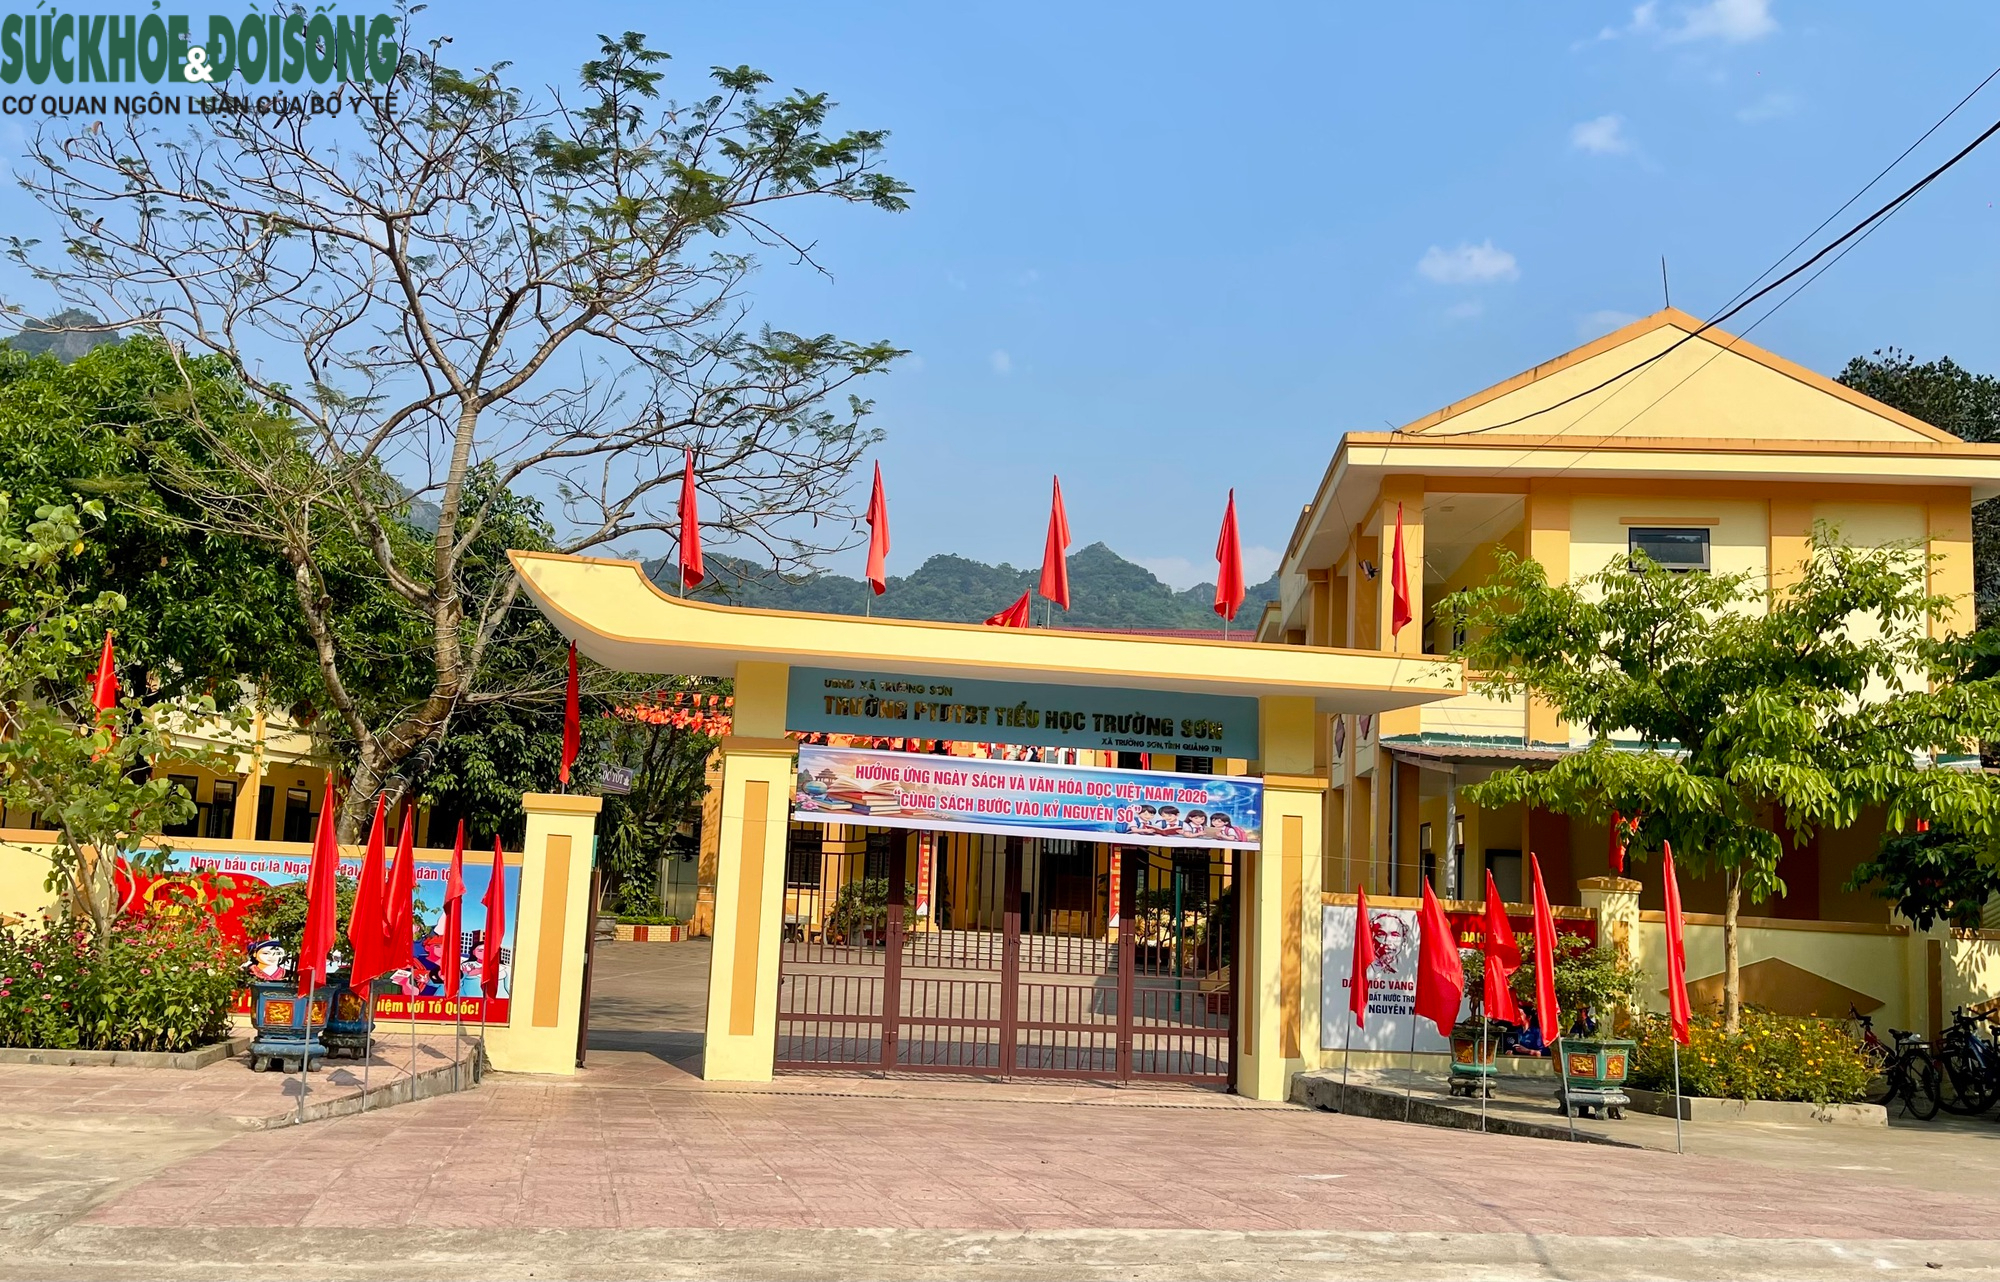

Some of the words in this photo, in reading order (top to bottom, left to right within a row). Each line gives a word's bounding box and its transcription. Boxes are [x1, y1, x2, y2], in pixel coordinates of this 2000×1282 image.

[860, 679, 876, 691] XÃ
[929, 685, 953, 697] SƠN
[824, 694, 908, 720] TRƯỜNG
[914, 701, 990, 726] PTDTBT
[995, 701, 1040, 728] TIỂU
[1045, 710, 1086, 734] HỌC
[1092, 711, 1174, 737] TRƯỜNG
[1180, 718, 1223, 740] SƠN
[1101, 737, 1113, 746] XÃ
[1115, 737, 1145, 748] TRƯỜNG
[1182, 742, 1210, 752] QUẢNG
[1211, 745, 1223, 754] TRỊ
[856, 762, 899, 781] HƯỞNG
[903, 765, 930, 784] ỨNG
[934, 769, 968, 786] NGÀY
[972, 772, 1005, 789] SÁCH
[1010, 775, 1025, 791] VÀ
[1029, 774, 1054, 793] VĂN
[1058, 778, 1083, 795] HÓA
[1087, 782, 1112, 799] ĐỌC
[1116, 782, 1142, 802] VIỆT
[1145, 786, 1174, 801] NAM
[1177, 789, 1208, 804] 2026
[940, 794, 974, 812] SÁCH
[978, 796, 1011, 815] BƯỚC
[1016, 798, 1040, 816] VÀO
[1043, 800, 1060, 818] KỶ
[1063, 805, 1113, 822] NGUYÊN
[190, 856, 221, 871] Ngày
[225, 857, 246, 870] bầu
[250, 858, 266, 873] cử
[269, 860, 280, 872] là
[416, 866, 438, 880] dân
[1388, 978, 1414, 991] VÀNG
[1369, 991, 1381, 1001] ĐẤT
[1383, 993, 1401, 1003] NƯỚC
[1403, 995, 1415, 1003] TRO
[428, 999, 443, 1014] Tổ
[1369, 1004, 1406, 1015] NGUYÊN
